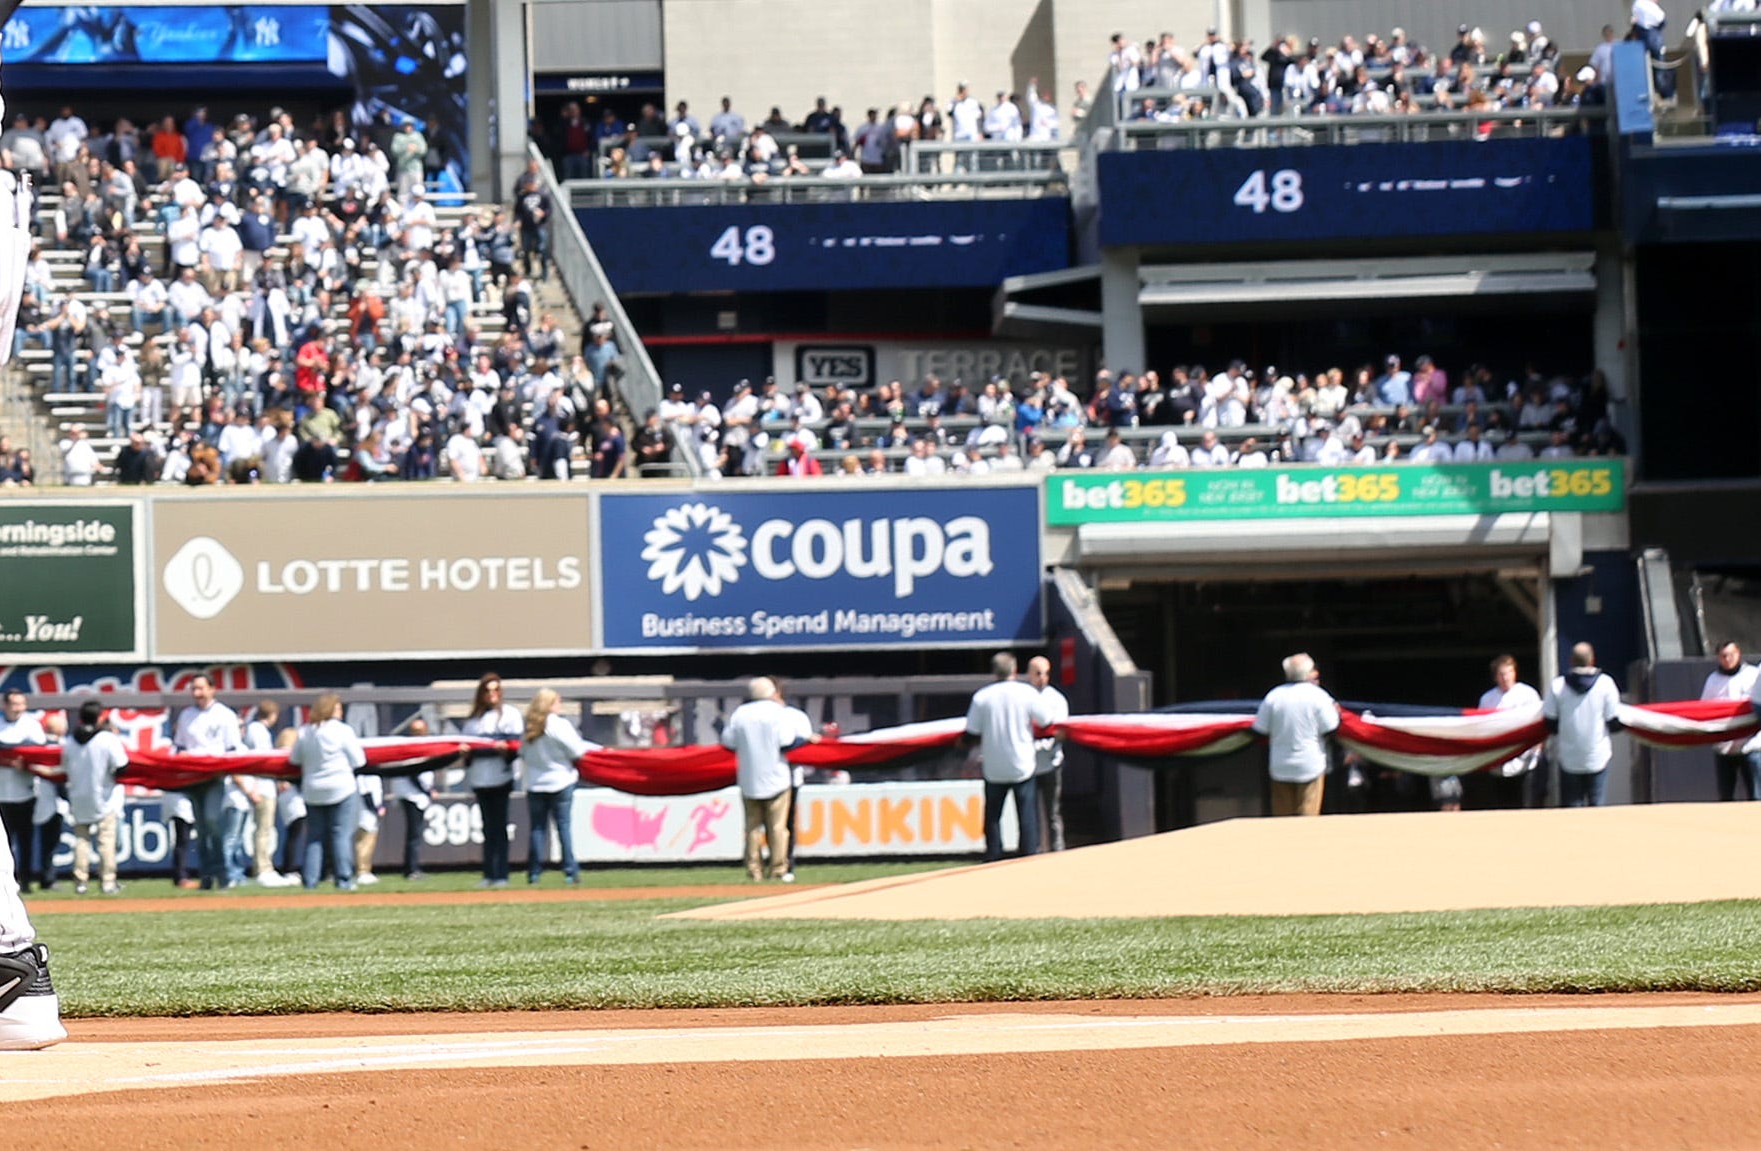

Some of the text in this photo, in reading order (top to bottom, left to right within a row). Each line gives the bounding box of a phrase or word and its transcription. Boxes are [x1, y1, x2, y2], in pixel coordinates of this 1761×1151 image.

[1232, 168, 1305, 214] 48
[709, 224, 776, 266] 48
[807, 349, 1080, 382] YES TERRACE
[1062, 480, 1186, 509] bet365
[1276, 473, 1400, 504] bet365
[1489, 468, 1612, 498] bet365
[750, 515, 994, 599] coupa
[257, 556, 582, 594] LOTTE HOTELS
[642, 608, 995, 639] Business Spend Management
[795, 794, 985, 846] UNKIN
